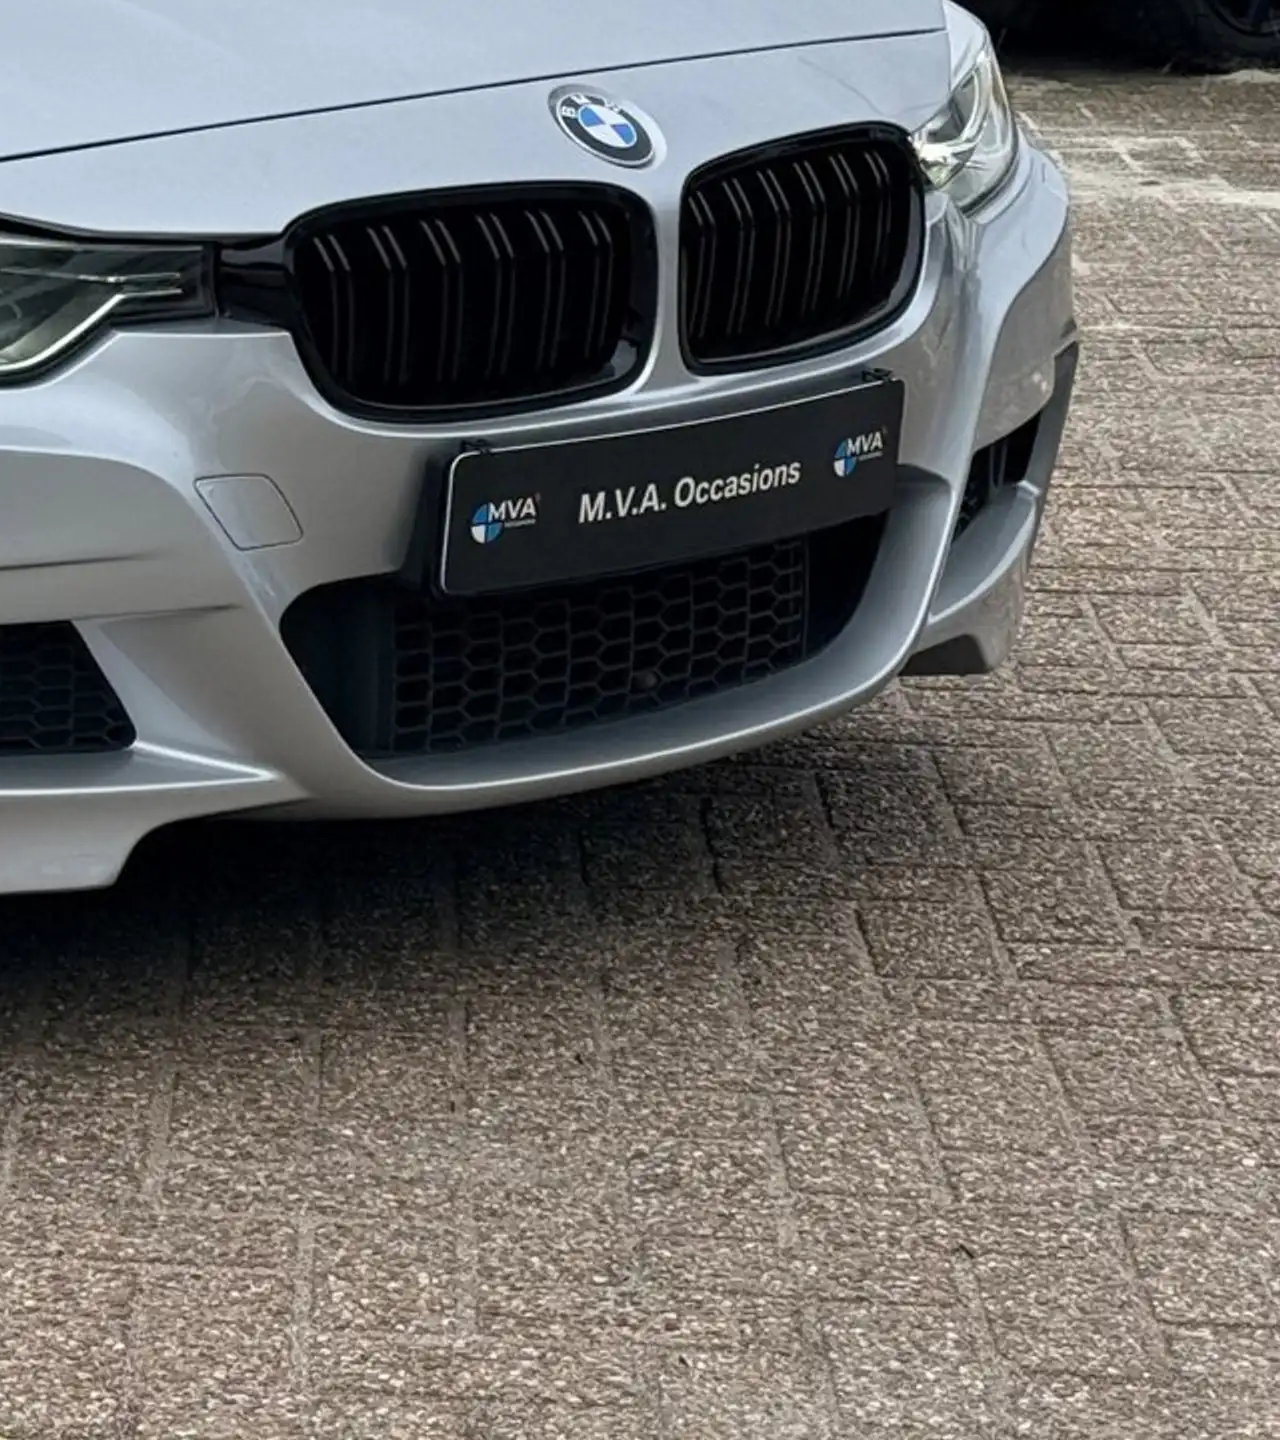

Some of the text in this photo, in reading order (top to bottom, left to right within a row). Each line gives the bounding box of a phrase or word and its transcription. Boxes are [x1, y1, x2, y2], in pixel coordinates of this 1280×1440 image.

[487, 497, 537, 523] MVA
[578, 460, 802, 525] M.V.A. Occasions
